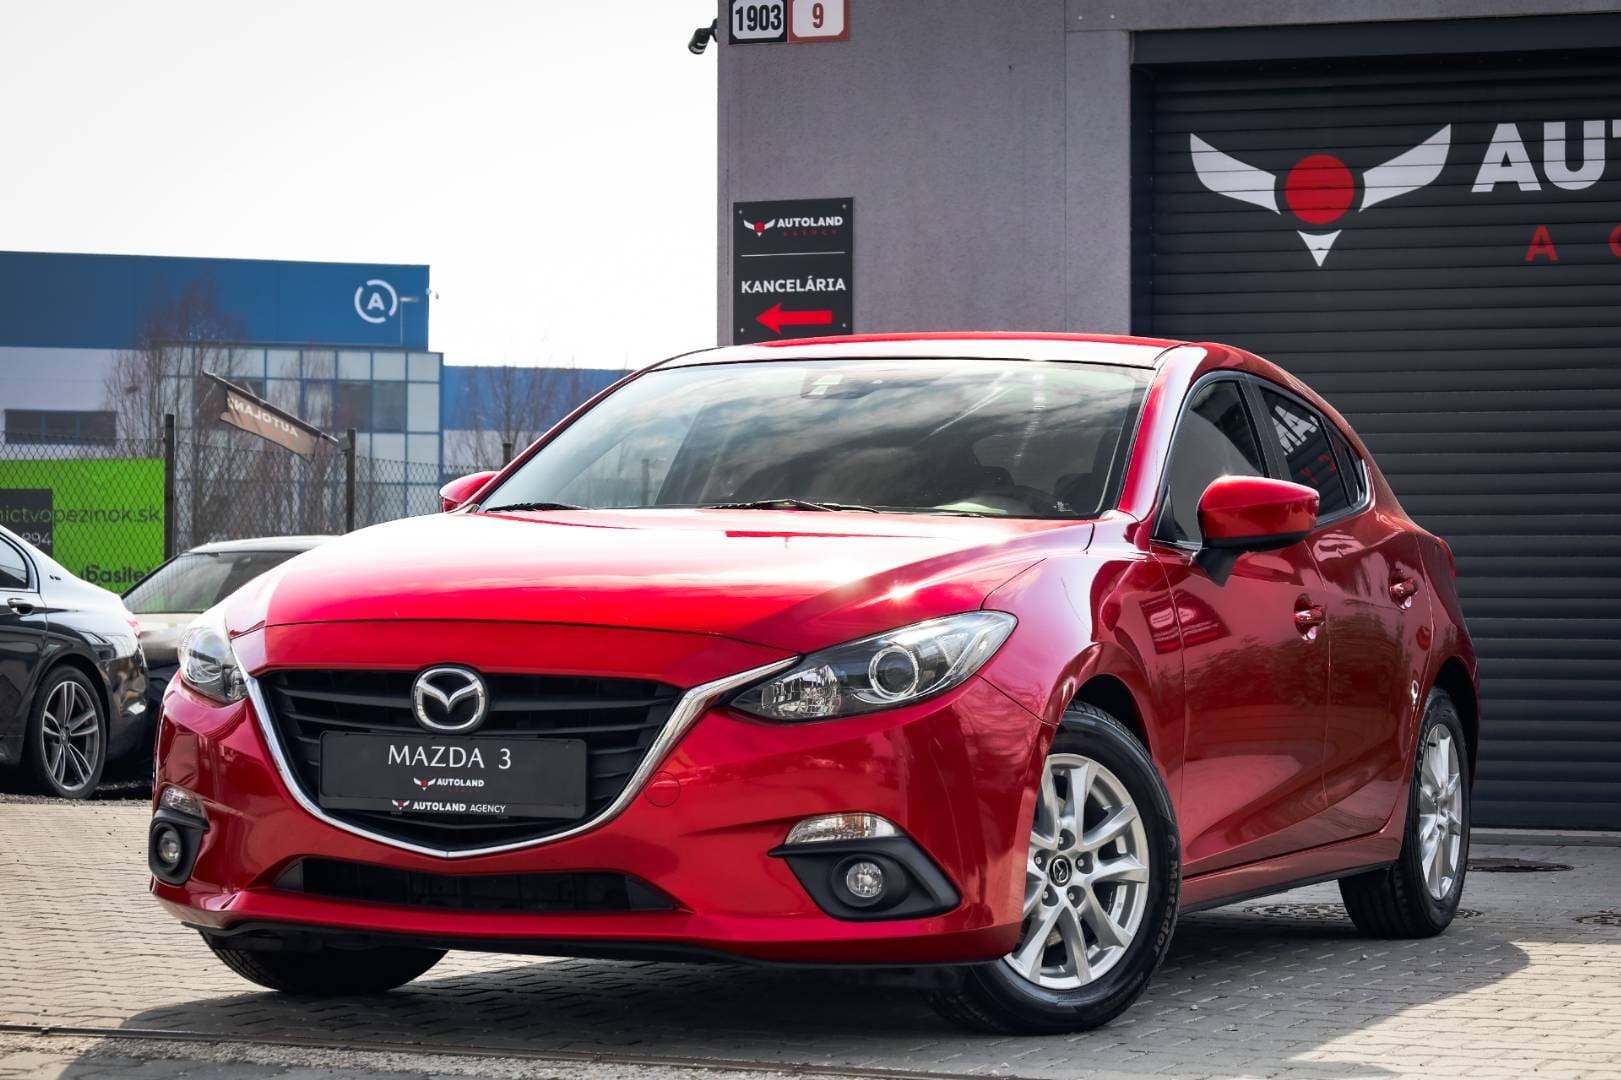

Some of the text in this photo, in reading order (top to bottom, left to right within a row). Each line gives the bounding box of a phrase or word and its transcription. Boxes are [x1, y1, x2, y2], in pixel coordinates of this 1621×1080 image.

[735, 4, 782, 31] 1903
[812, 3, 824, 28] 9
[1471, 119, 1621, 193] AU
[777, 216, 844, 228] AUTOLAND
[741, 275, 847, 294] KANCELÁRIA
[388, 745, 511, 769] MAZDA 3
[436, 778, 485, 787] AUTOLAND
[412, 801, 506, 813] AUTOLAND AGENCY
